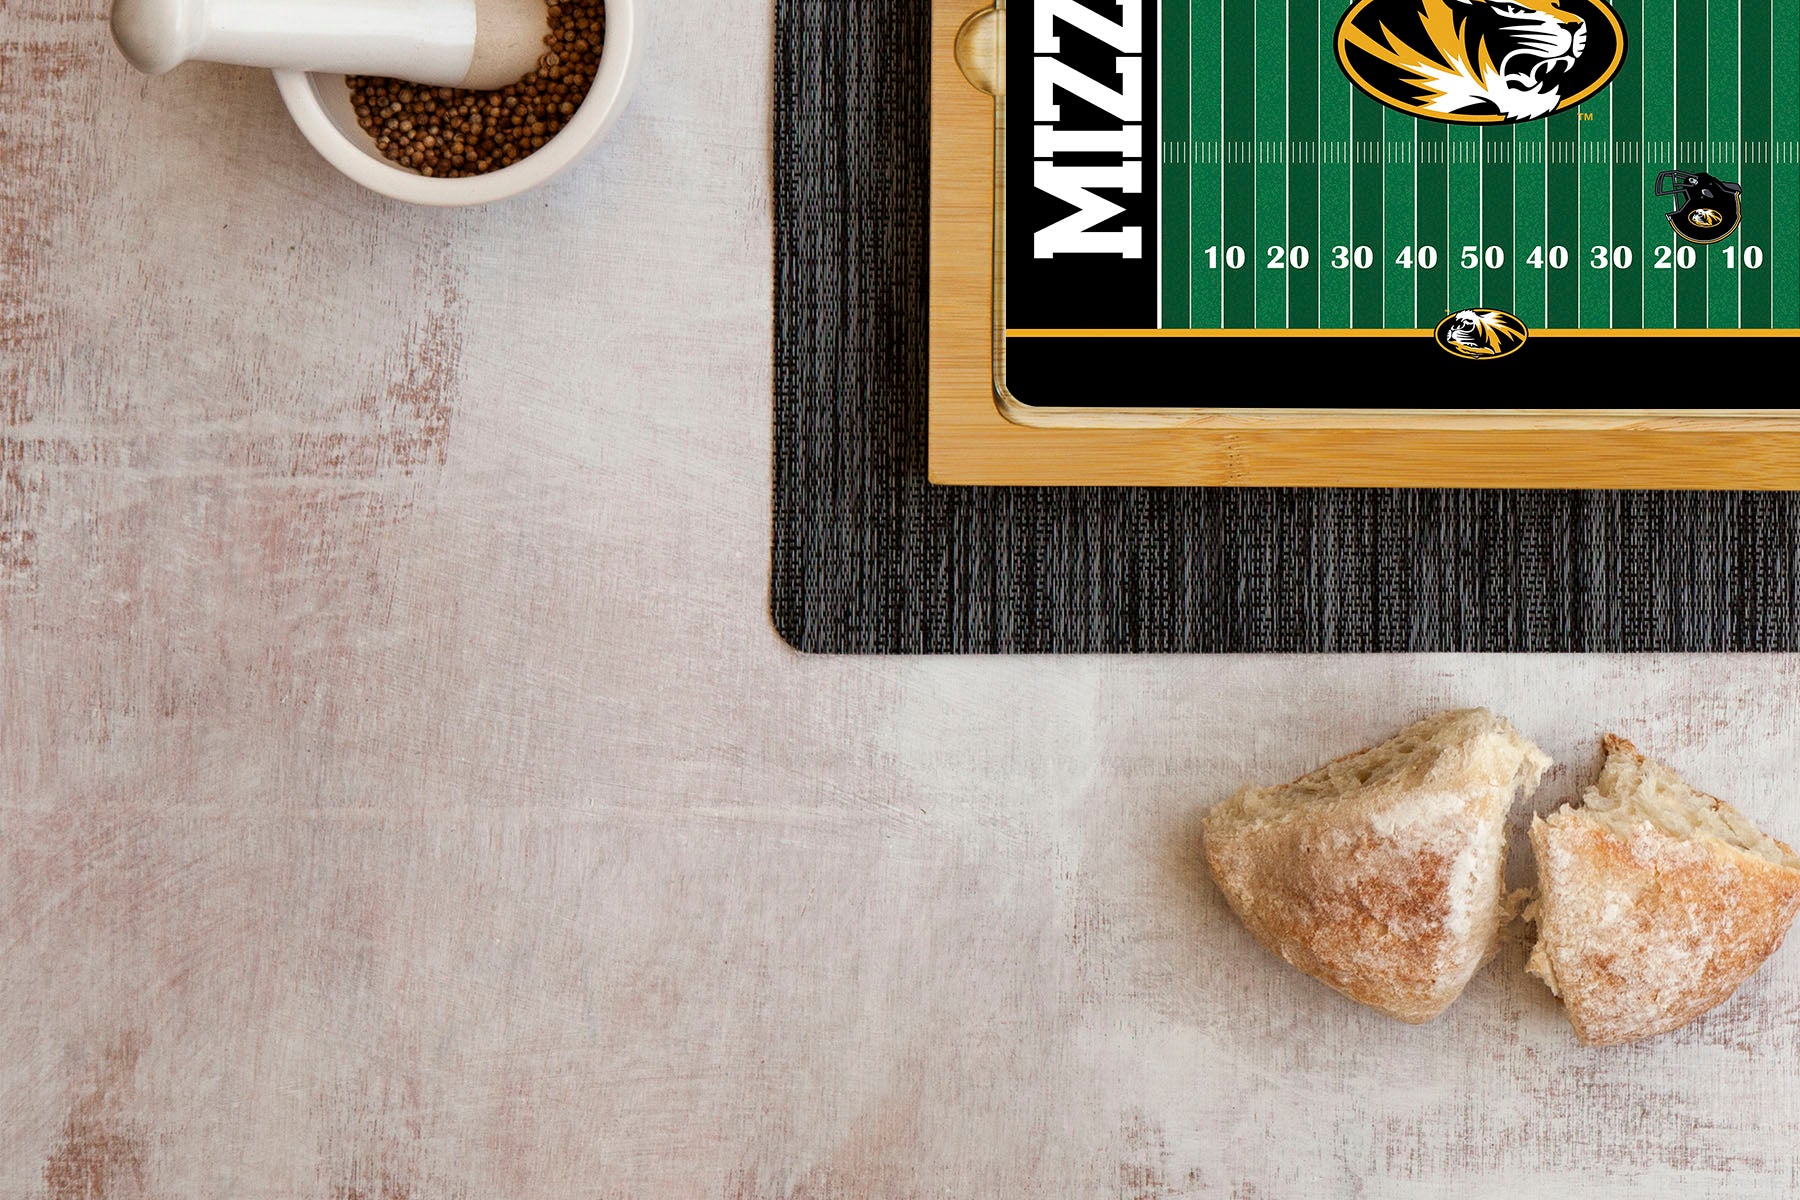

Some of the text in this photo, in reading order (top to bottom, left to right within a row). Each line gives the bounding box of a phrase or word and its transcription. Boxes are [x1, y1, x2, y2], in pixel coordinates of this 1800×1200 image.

[1204, 245, 1763, 269] 10 20 30 40 50 40 30 20 10
